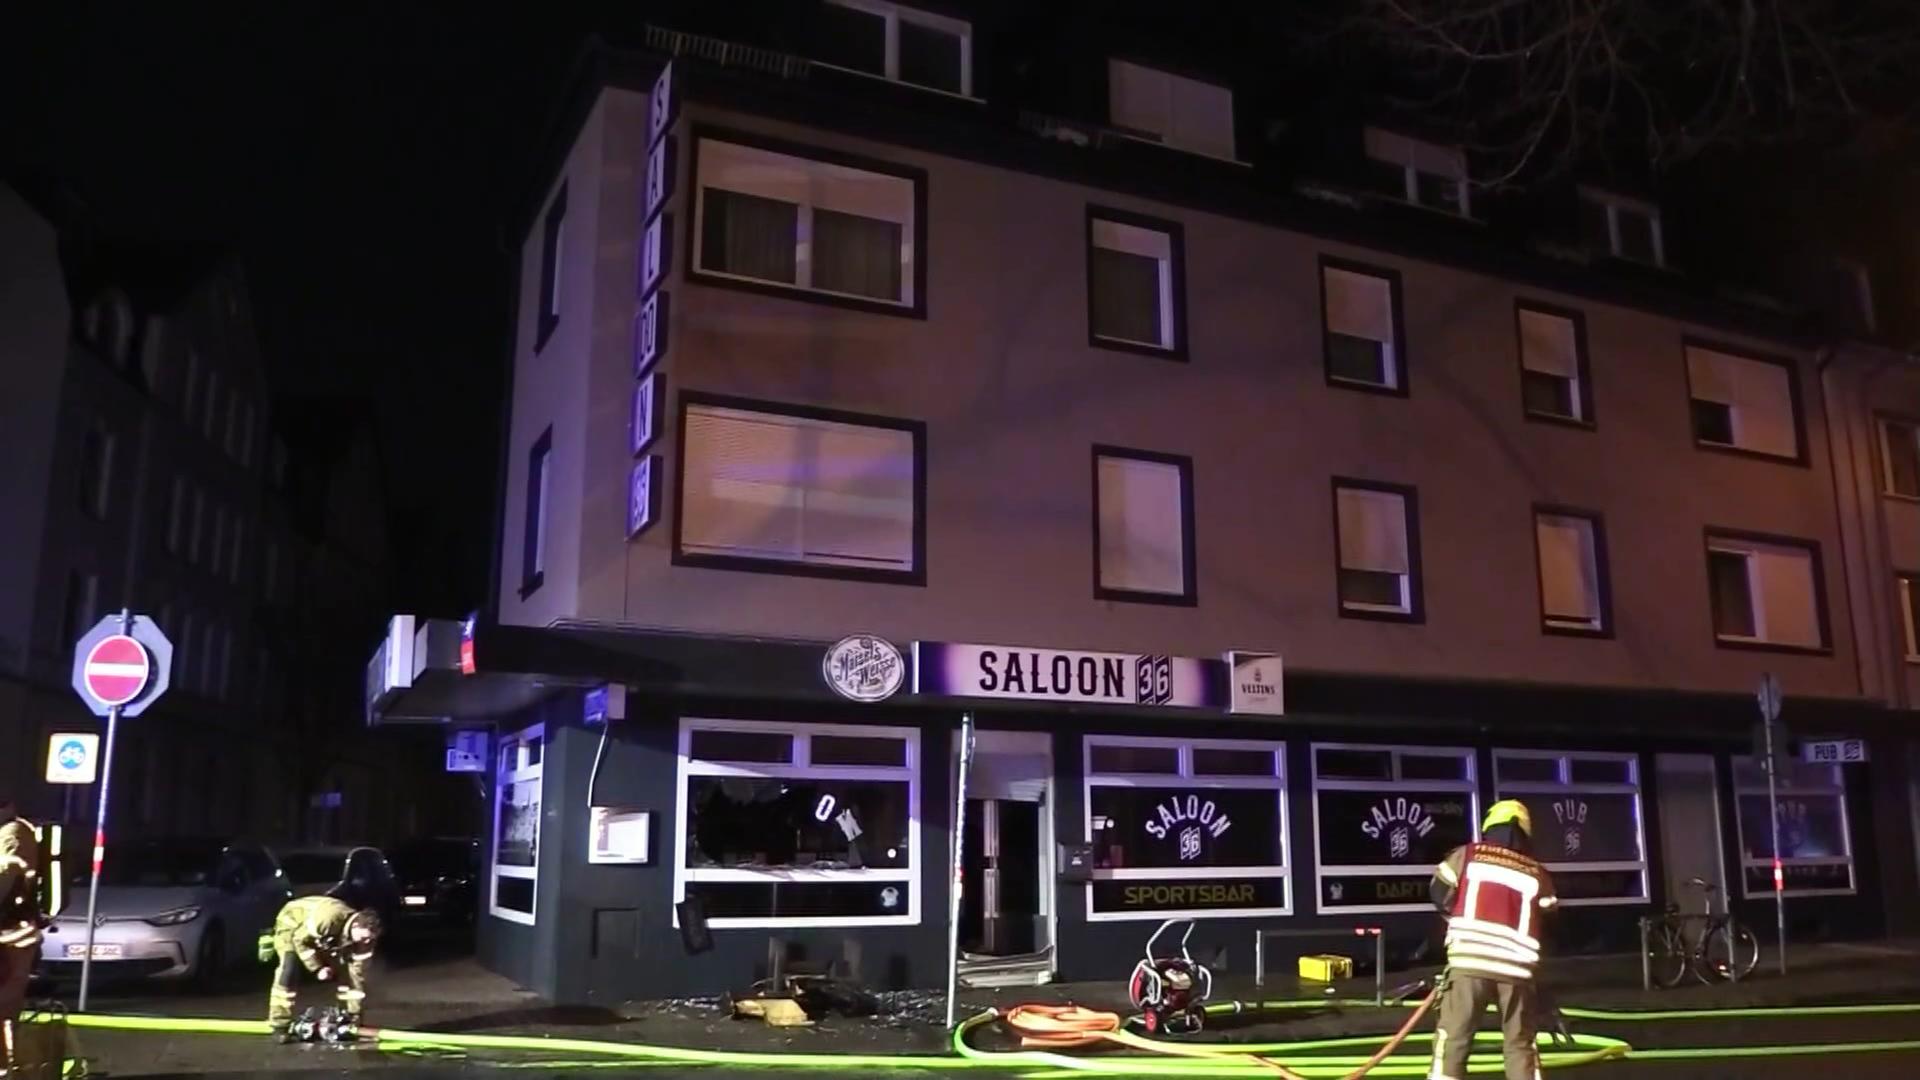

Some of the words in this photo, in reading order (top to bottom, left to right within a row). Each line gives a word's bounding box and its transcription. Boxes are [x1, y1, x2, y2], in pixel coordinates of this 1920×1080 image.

[979, 651, 1125, 697] SALOON
[1138, 660, 1171, 700] 36
[1241, 683, 1275, 695] VELTINS
[1815, 744, 1837, 760] PUB
[1145, 794, 1231, 839] SALOON
[1361, 797, 1435, 839] SALOON
[1553, 799, 1588, 824] PUB
[1181, 830, 1201, 855] 36
[1124, 884, 1255, 904] SPORTSBAR
